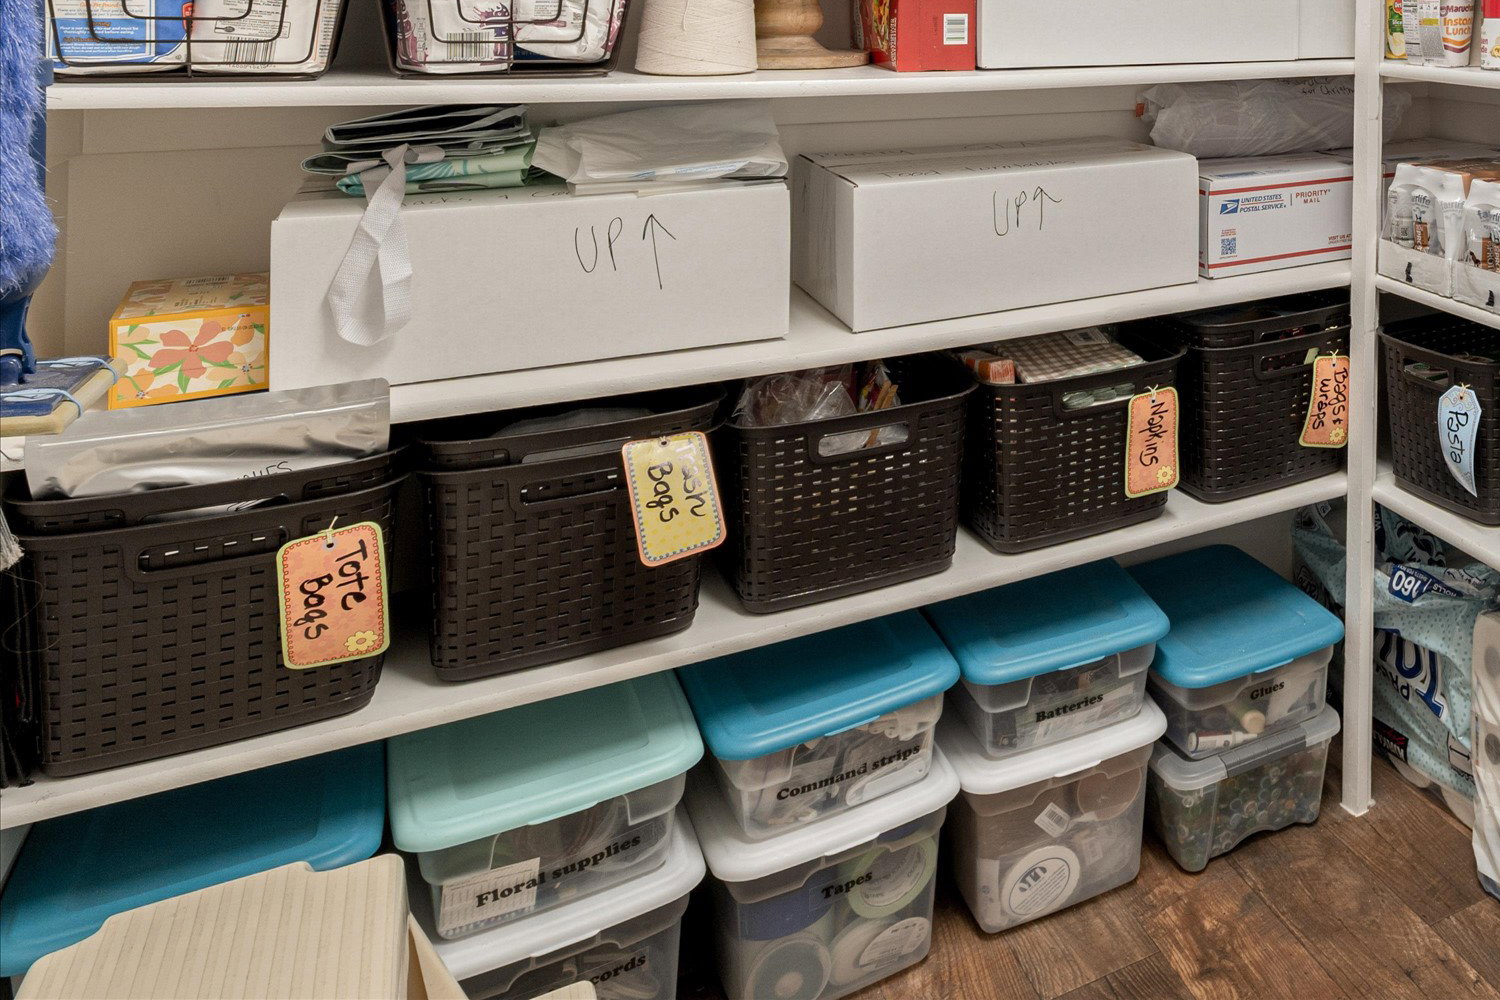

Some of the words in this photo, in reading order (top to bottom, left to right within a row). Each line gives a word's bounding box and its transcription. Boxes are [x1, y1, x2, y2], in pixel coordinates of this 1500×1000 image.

[993, 188, 1027, 238] UP
[1239, 205, 1260, 214] POSTAL
[1260, 202, 1285, 211] SERVICE
[1240, 195, 1261, 204] UNITED
[1261, 193, 1282, 202] STATES
[1295, 189, 1327, 199] PRIORITY
[1303, 196, 1321, 205] MAIL
[574, 217, 622, 275] UP
[1139, 400, 1168, 467] Napkins
[1446, 409, 1470, 465] Pasta
[646, 460, 679, 523] Bags
[335, 538, 368, 612] Tote
[1392, 572, 1421, 599] 160
[295, 573, 333, 641] Bags
[1036, 692, 1104, 723] Batteries
[1250, 680, 1285, 701] Glues
[776, 763, 869, 801] Command
[871, 742, 921, 774] strips
[476, 870, 548, 908] Floral
[551, 833, 642, 882] supplies
[821, 869, 873, 900] Tapes
